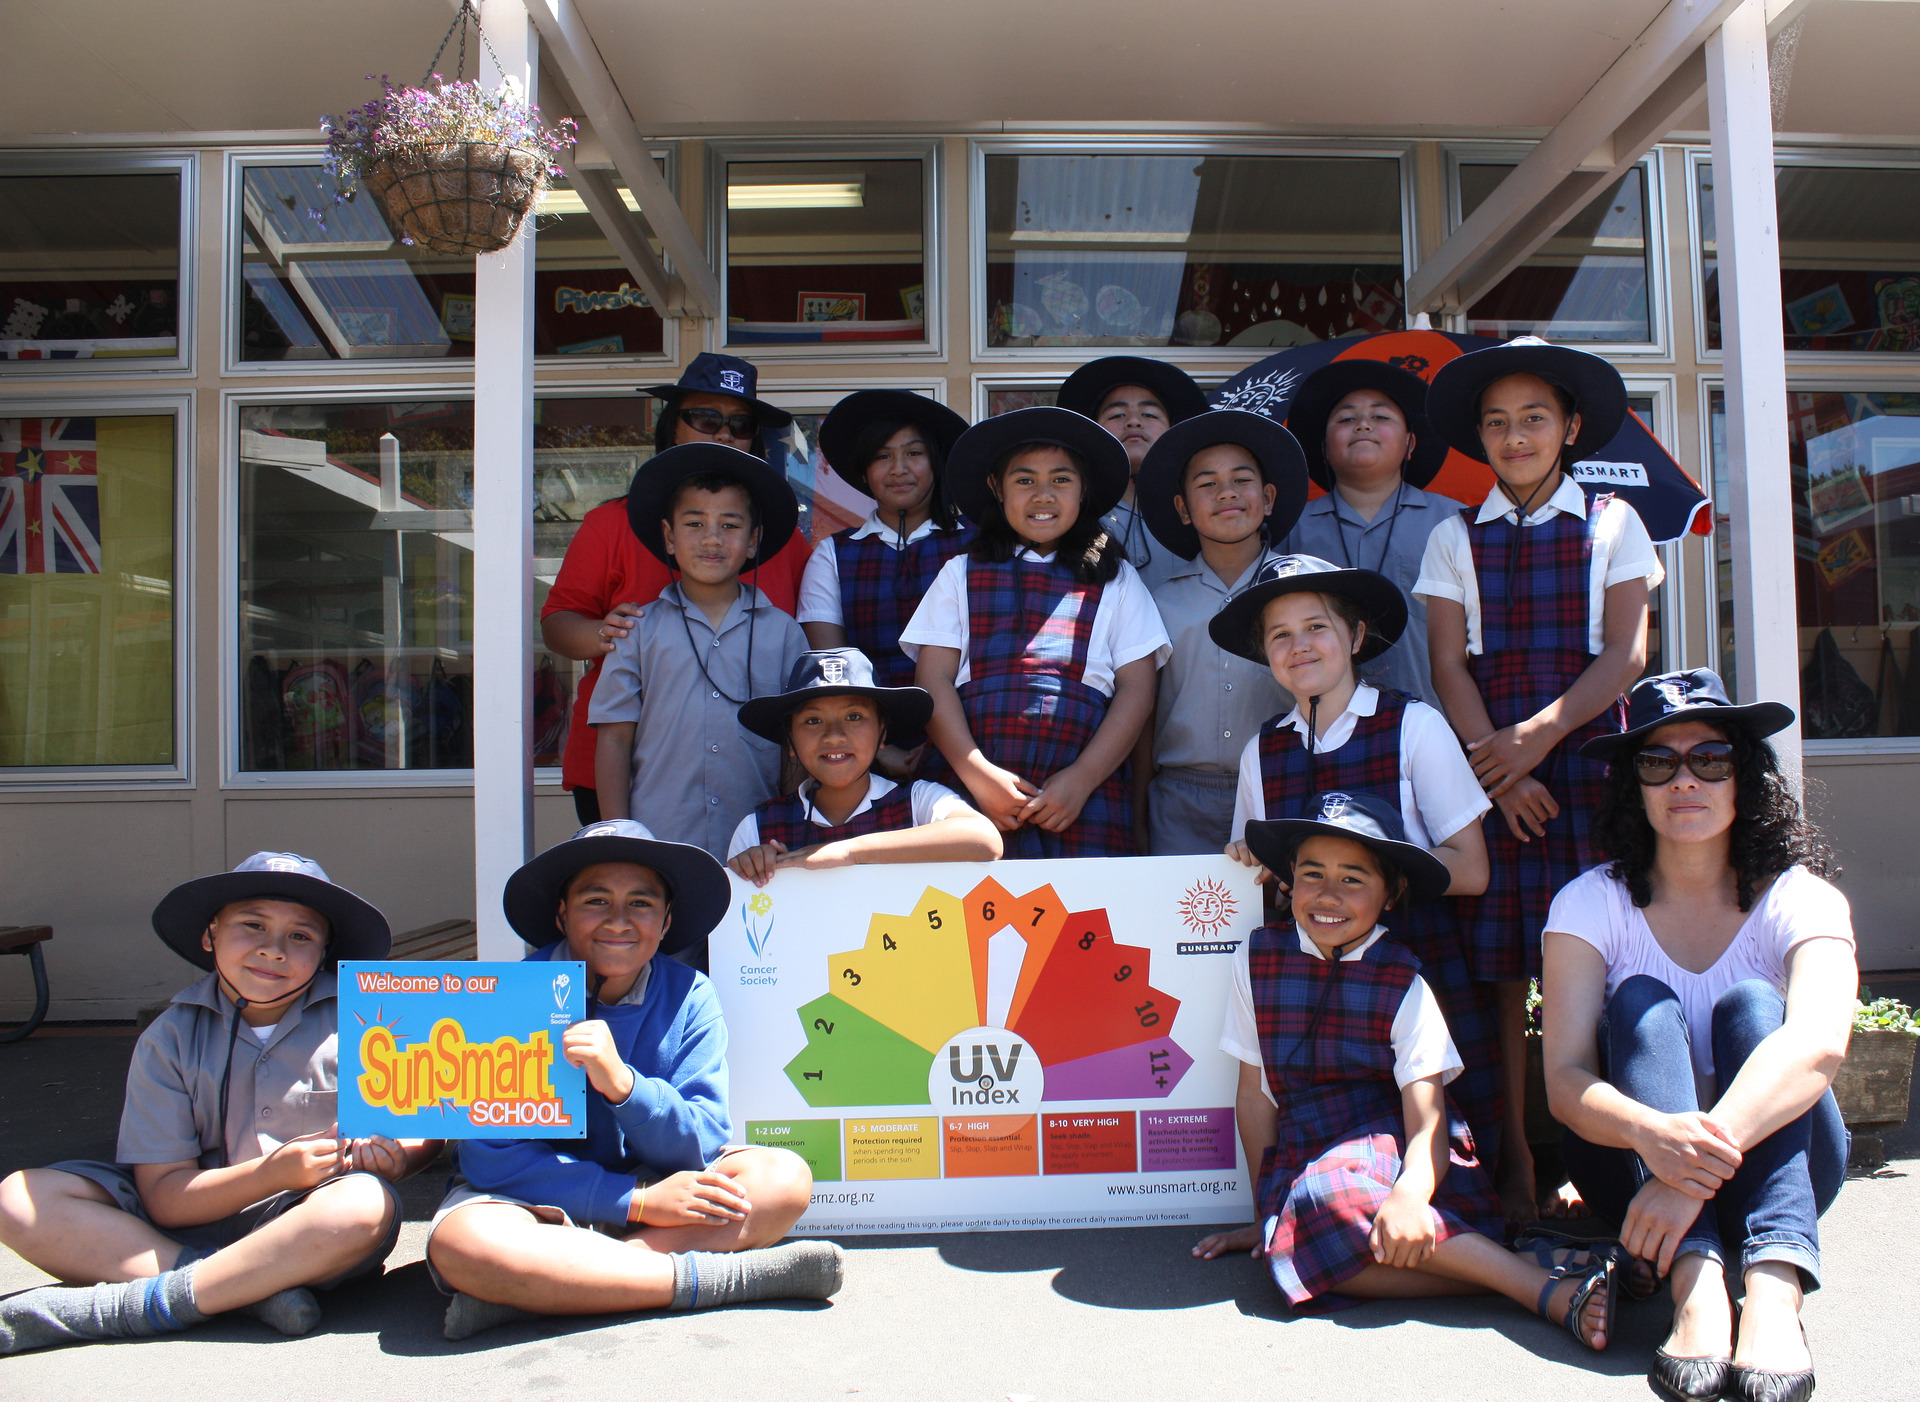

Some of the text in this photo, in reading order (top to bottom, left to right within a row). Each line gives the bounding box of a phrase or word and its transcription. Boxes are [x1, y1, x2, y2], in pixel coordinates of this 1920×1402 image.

[1573, 466, 1639, 478] NSMART
[982, 901, 996, 921] 6
[1031, 906, 1045, 927] 7
[927, 909, 942, 930] 5
[882, 933, 897, 951] 4
[1078, 931, 1097, 951] 8
[740, 965, 777, 974] Cancer
[843, 968, 862, 986] 3
[1113, 964, 1133, 982] 9
[358, 973, 498, 992] Welcome to our
[740, 976, 778, 986] Society
[1134, 1000, 1160, 1028] 10
[814, 1018, 835, 1035] 2
[363, 1022, 551, 1110] SunSmart
[949, 1043, 1023, 1083] UV
[1149, 1048, 1171, 1089] 11+
[803, 1069, 823, 1081] 1
[952, 1086, 1020, 1105] Index
[472, 1101, 569, 1124] SCHOOL
[1168, 1115, 1208, 1124] EXTREME
[852, 1124, 919, 1133] 3-5 MODERATE
[949, 1122, 990, 1131] 6-7 HIGH
[1073, 1119, 1095, 1127] VERY
[1097, 1118, 1119, 1126] HIGH
[755, 1127, 791, 1135] 1-2 LOW
[1148, 1128, 1188, 1136] Reschedule
[892, 1136, 923, 1144] required
[1148, 1137, 1180, 1145] activities
[1194, 1136, 1213, 1144] early
[873, 1147, 904, 1156] spending
[905, 1147, 921, 1155] long
[853, 1157, 877, 1165] periods
[1107, 1180, 1237, 1195] www.sunsmart.org.nz
[809, 1192, 875, 1206] ernz.org.nz
[809, 1223, 821, 1231] the
[822, 1222, 844, 1231] safety
[846, 1222, 855, 1230] of
[856, 1222, 875, 1230] those
[877, 1221, 905, 1230] reading
[907, 1221, 920, 1229] this
[922, 1221, 938, 1230] sign,
[940, 1220, 964, 1229] please
[965, 1219, 991, 1227] update
[993, 1218, 1010, 1227] daily
[1022, 1217, 1047, 1226] display
[1089, 1215, 1106, 1224] daily
[1108, 1214, 1144, 1222] maximum
